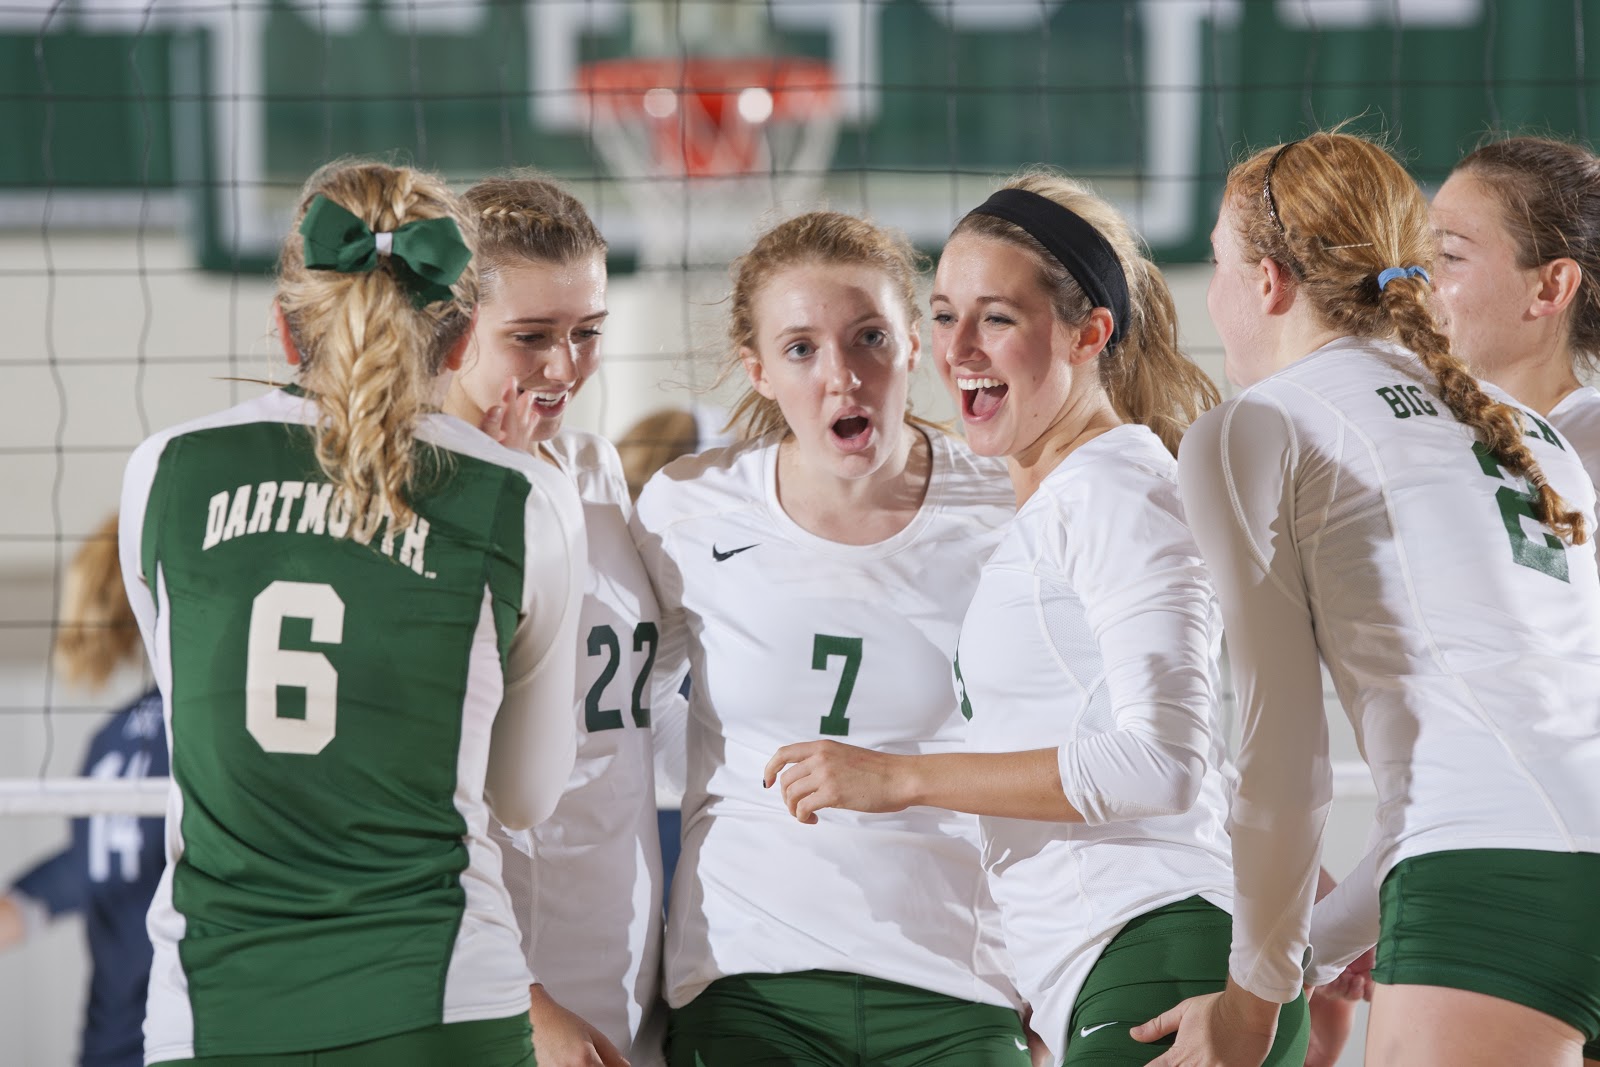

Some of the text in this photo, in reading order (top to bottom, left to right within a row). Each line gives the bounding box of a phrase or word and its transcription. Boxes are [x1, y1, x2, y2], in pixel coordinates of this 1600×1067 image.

[1375, 384, 1438, 419] BIG
[202, 480, 431, 575] DARTMOUTH
[246, 580, 345, 755] 6
[585, 621, 659, 733] 22
[811, 633, 863, 737] 7
